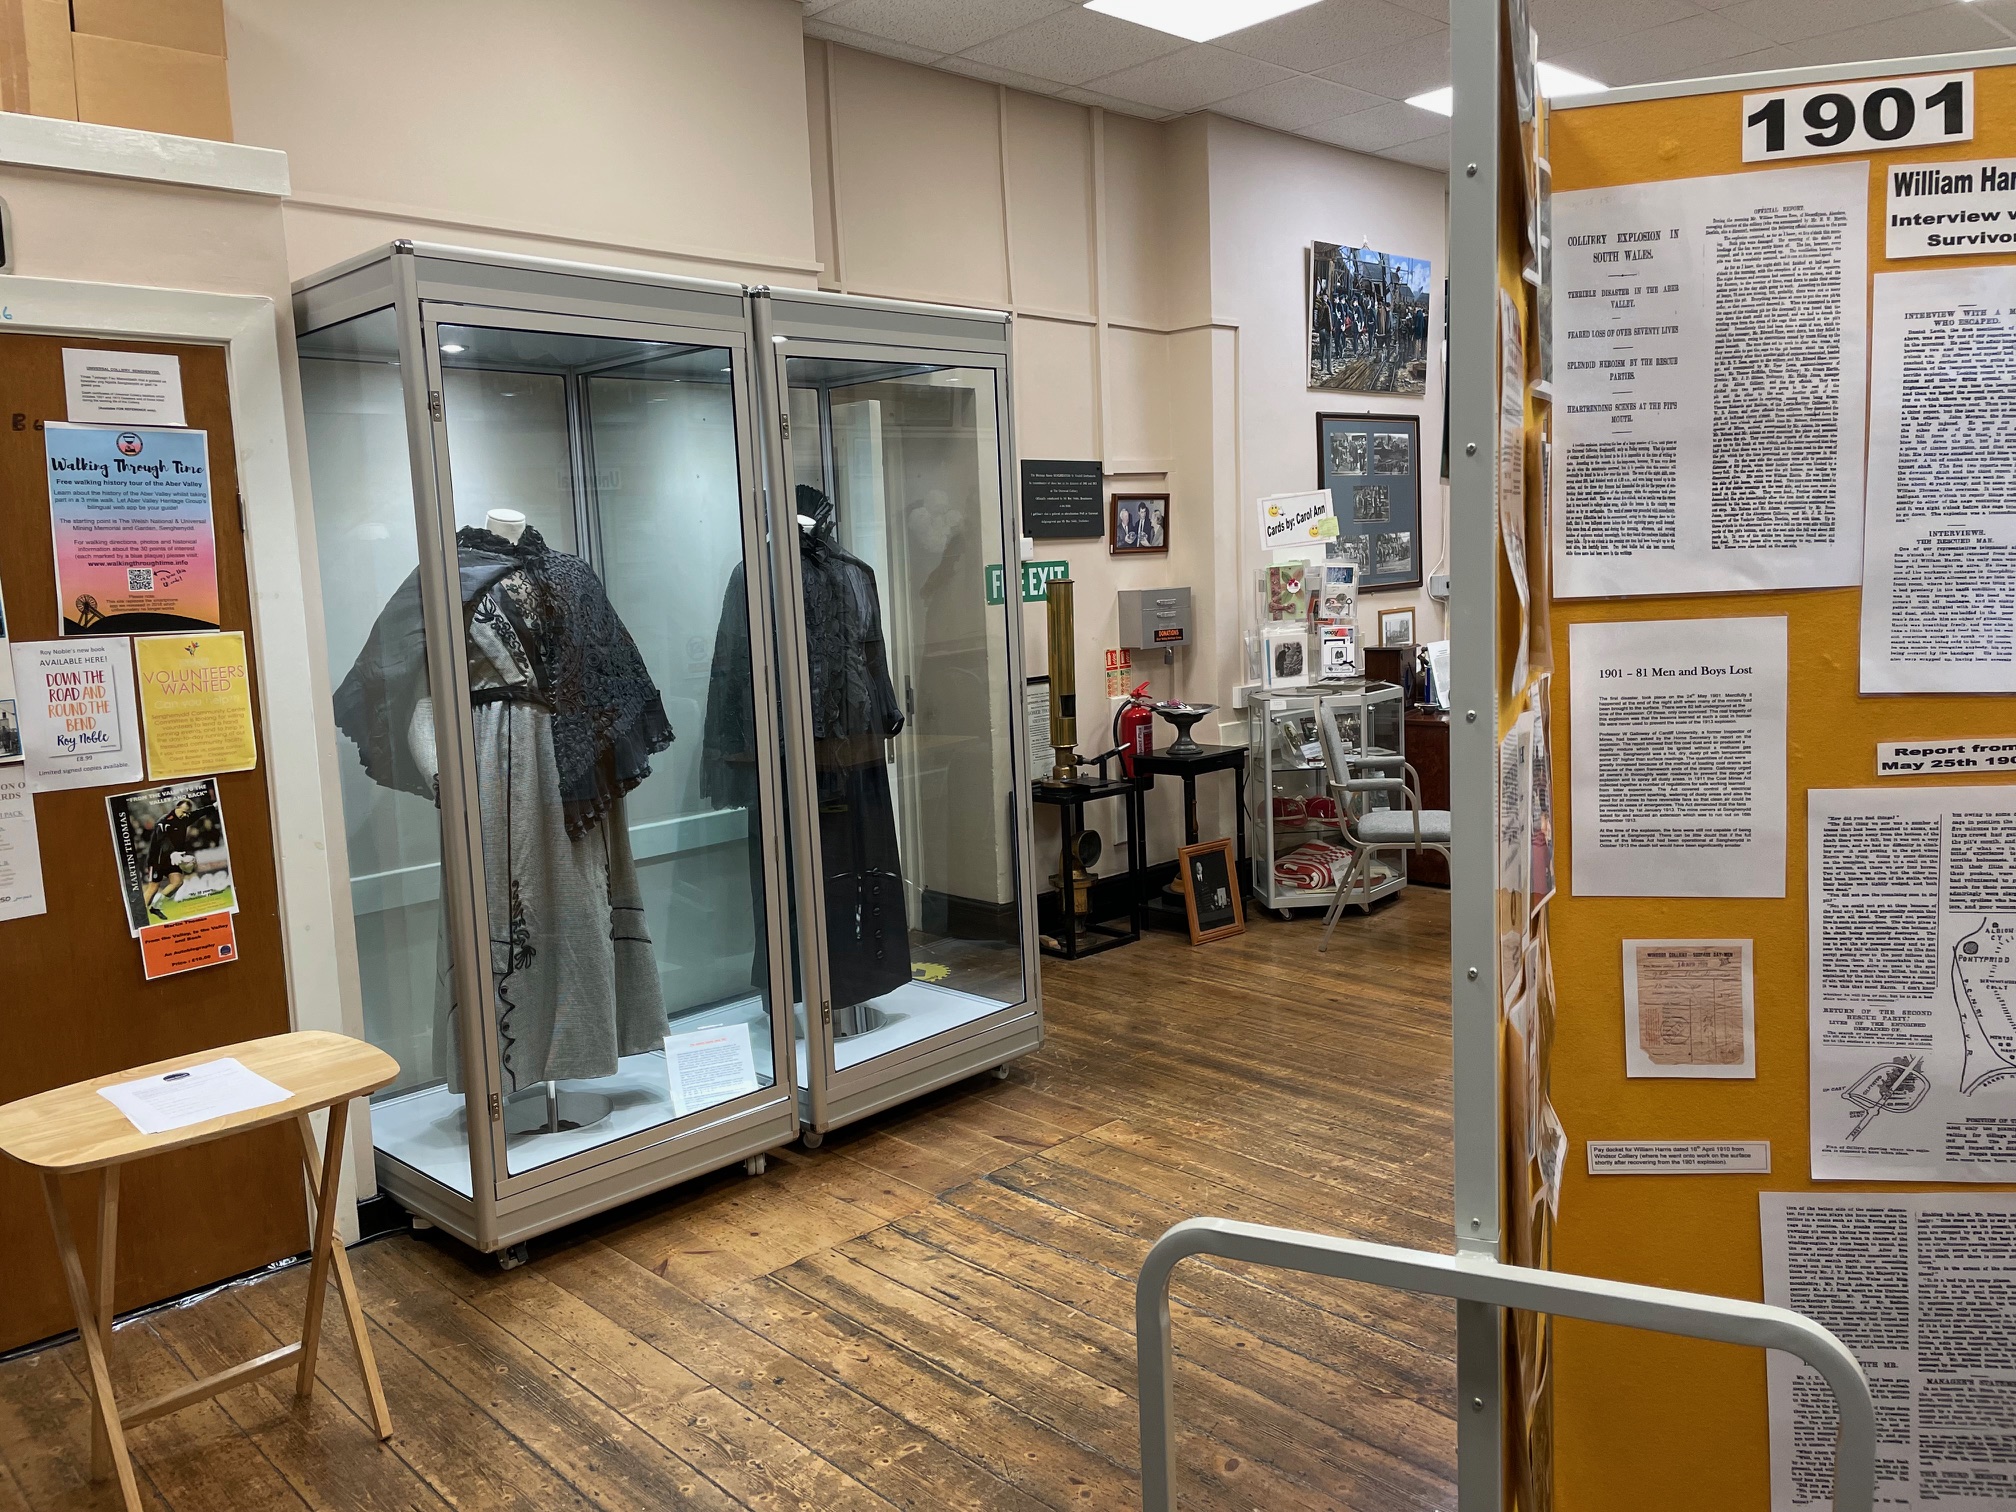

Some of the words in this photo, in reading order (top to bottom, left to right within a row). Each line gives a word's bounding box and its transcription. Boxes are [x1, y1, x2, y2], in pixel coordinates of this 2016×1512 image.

[1748, 81, 1964, 152] 1901
[1894, 167, 1972, 196] William
[1891, 210, 2000, 227] Interview
[1567, 234, 1607, 246] COLLIERY
[1617, 230, 1661, 243] EXPLOSION
[1670, 228, 1679, 238] IN
[1927, 231, 2016, 247] Survivo
[1592, 250, 1619, 263] SOUTH
[1624, 248, 1653, 261] WALES.
[1567, 289, 1596, 298] TERRIBLE
[1601, 287, 1629, 297] DISASTER
[1634, 286, 1641, 294] IN
[1645, 285, 1658, 294] THE
[1662, 284, 1679, 292] ABER
[1610, 299, 1635, 308] VALLEY.
[1904, 310, 1955, 319] INTERVIEW
[1963, 308, 1986, 316] WITH
[1958, 317, 2001, 325] ESCAPED.
[1567, 330, 1590, 339] FEARED
[1591, 329, 1605, 338] LOSS
[1606, 328, 1615, 337] OF
[1615, 328, 1632, 336] OVER
[1633, 326, 1659, 335] SEVENTY
[1661, 325, 1678, 334] LIVES
[1567, 360, 1595, 369] SPLENDID
[1598, 359, 1625, 368] HEROISM
[1629, 358, 1637, 366] BY
[1640, 357, 1653, 366] THE
[1655, 356, 1678, 365] RESCUE
[1567, 403, 1612, 413] HEARTRENDING
[1614, 402, 1636, 411] SCENES
[1638, 402, 1646, 410] AT
[1648, 401, 1661, 410] THE
[51, 458, 109, 478] Walking
[114, 459, 169, 479] Through
[172, 460, 204, 475] Time
[165, 480, 180, 488] Aber
[1266, 520, 1285, 538] Cards
[1285, 517, 1296, 532] by:
[1296, 510, 1312, 525] Carol
[1313, 504, 1326, 516] Ann
[88, 560, 188, 569] www.walkingthroughtime.info
[1029, 566, 1065, 596] EXIT
[1158, 629, 1179, 637] DONATIONS
[39, 657, 82, 666] AVAILABLE
[84, 655, 107, 663] HERE!
[46, 671, 81, 687] DOWN
[82, 670, 106, 684] THE
[143, 665, 244, 684] VOLUNTEERS
[1600, 668, 1622, 678] 1901
[1636, 668, 1647, 677] 81
[1651, 667, 1675, 676] Men
[1678, 667, 1697, 675] and
[1701, 666, 1726, 677] Boys
[1729, 665, 1752, 674] Lost
[50, 688, 80, 702] ROAD
[82, 686, 106, 700] AND
[162, 680, 230, 695] WANTED
[48, 702, 87, 718] ROUND
[88, 700, 111, 714] THE
[66, 718, 96, 732] BEND
[57, 736, 78, 752] Roy
[79, 730, 109, 745] Noble
[1894, 746, 1965, 757] Report
[38, 769, 62, 778] Limited
[103, 762, 130, 770] available.
[1881, 760, 1924, 771] May
[1930, 758, 1977, 768] 25th
[118, 811, 133, 854] THOMAS
[127, 854, 140, 892] MARTIN
[173, 943, 215, 954] Autobiography
[1958, 955, 2010, 963] PONTYPRIDD
